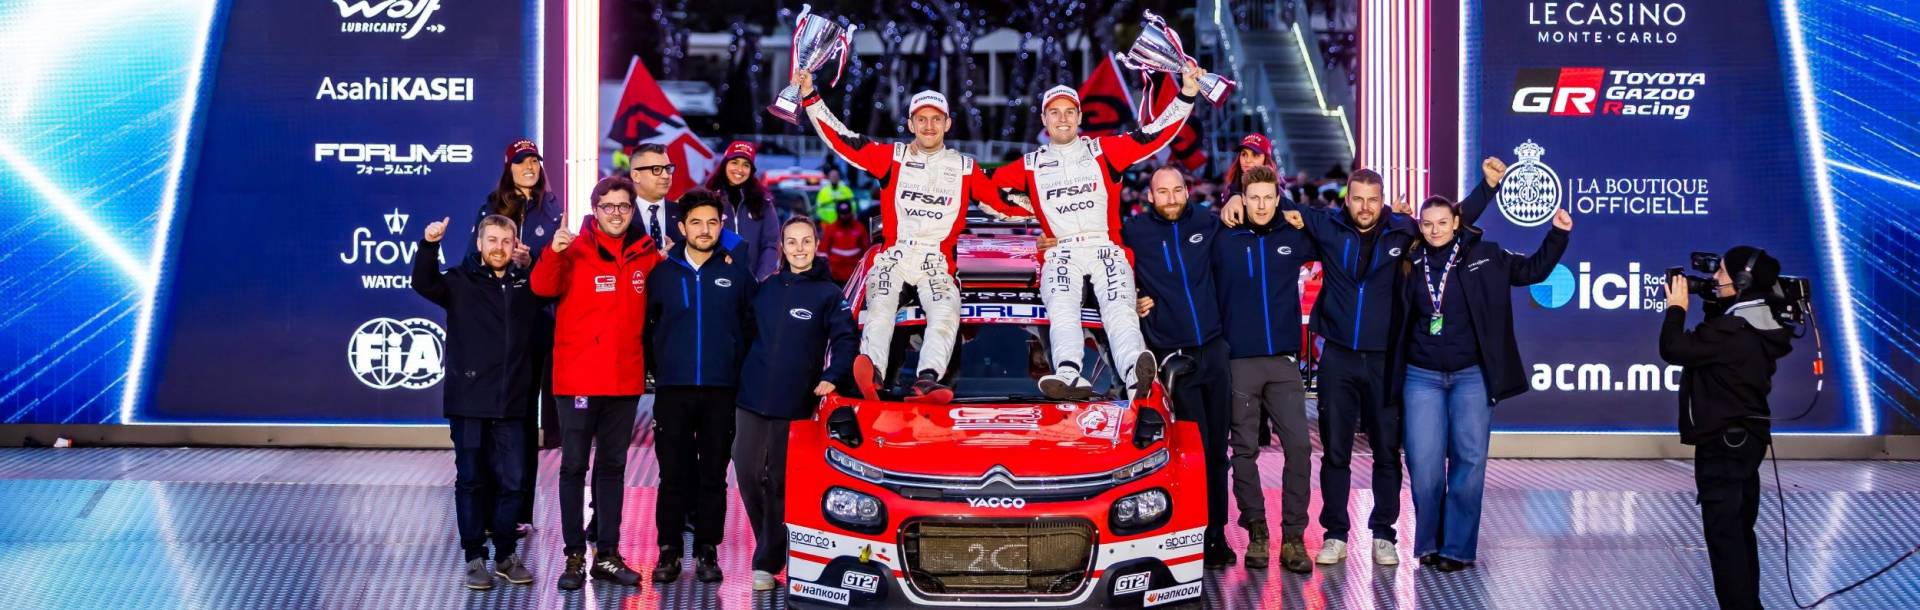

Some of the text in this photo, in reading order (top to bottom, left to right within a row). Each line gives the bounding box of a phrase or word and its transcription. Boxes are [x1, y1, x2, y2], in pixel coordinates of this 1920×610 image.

[1529, 2, 1686, 26] LE CASINO
[341, 22, 408, 33] LUBRICANTS
[1609, 70, 1706, 85] TOYOTA
[1511, 86, 1597, 113] GR
[1605, 86, 1695, 101] GAZOO
[1602, 101, 1691, 119] Racing
[315, 143, 473, 163] FORUM8
[356, 164, 431, 175] フォーラムエイト
[1046, 182, 1092, 200] FFSA
[1577, 178, 1709, 199] LA BOUTIQUE
[901, 190, 948, 206] FFSA
[1577, 197, 1709, 214] OFFICIELLE
[905, 208, 943, 219] YACCO
[1056, 200, 1095, 214] YACCO
[1579, 262, 1640, 310] ici
[1644, 286, 1659, 297] TV
[1531, 363, 1685, 391] acm.mc
[966, 497, 1025, 509] YACCO
[791, 531, 830, 546] sparco
[1165, 533, 1203, 548] sparco
